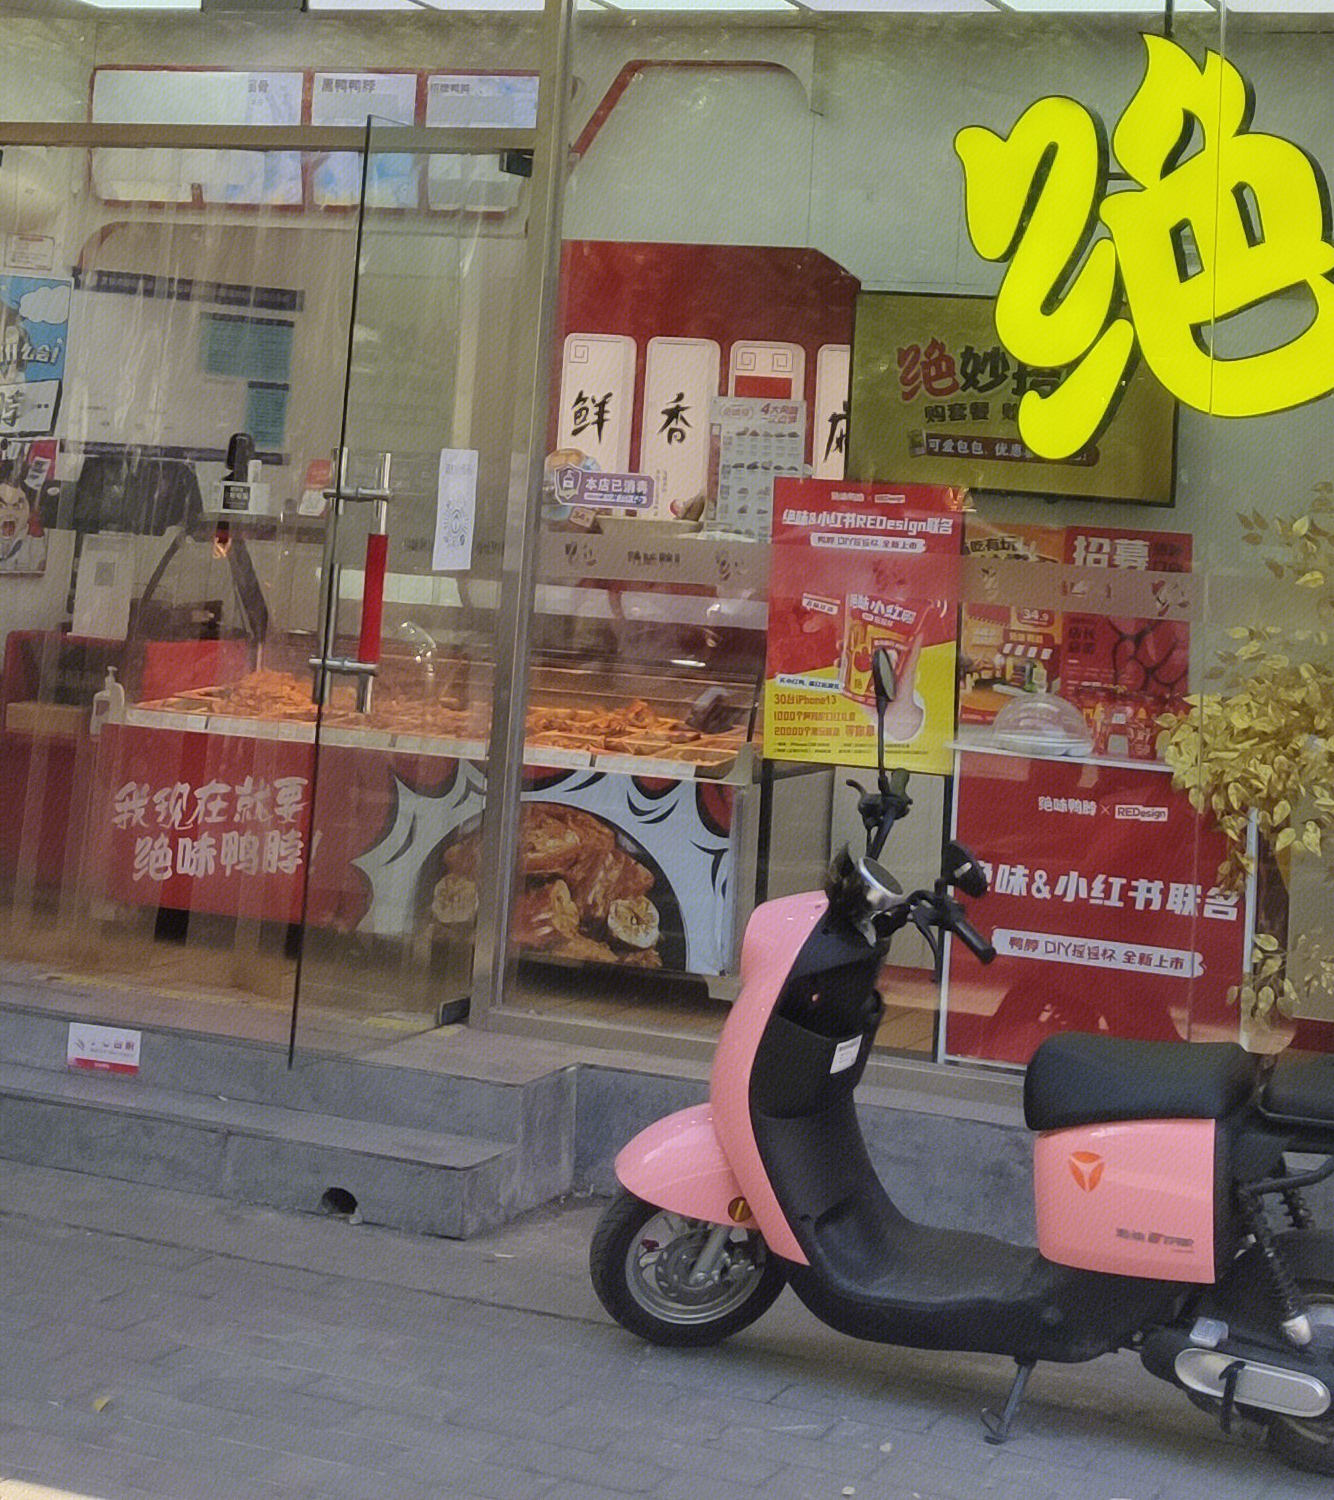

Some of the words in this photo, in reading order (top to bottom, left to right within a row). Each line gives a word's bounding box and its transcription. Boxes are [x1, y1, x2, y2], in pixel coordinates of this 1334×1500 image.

[570, 389, 613, 445] 鲜
[657, 391, 694, 446] 香
[111, 774, 309, 830] 我现在就要
[1117, 806, 1167, 821] REDesign
